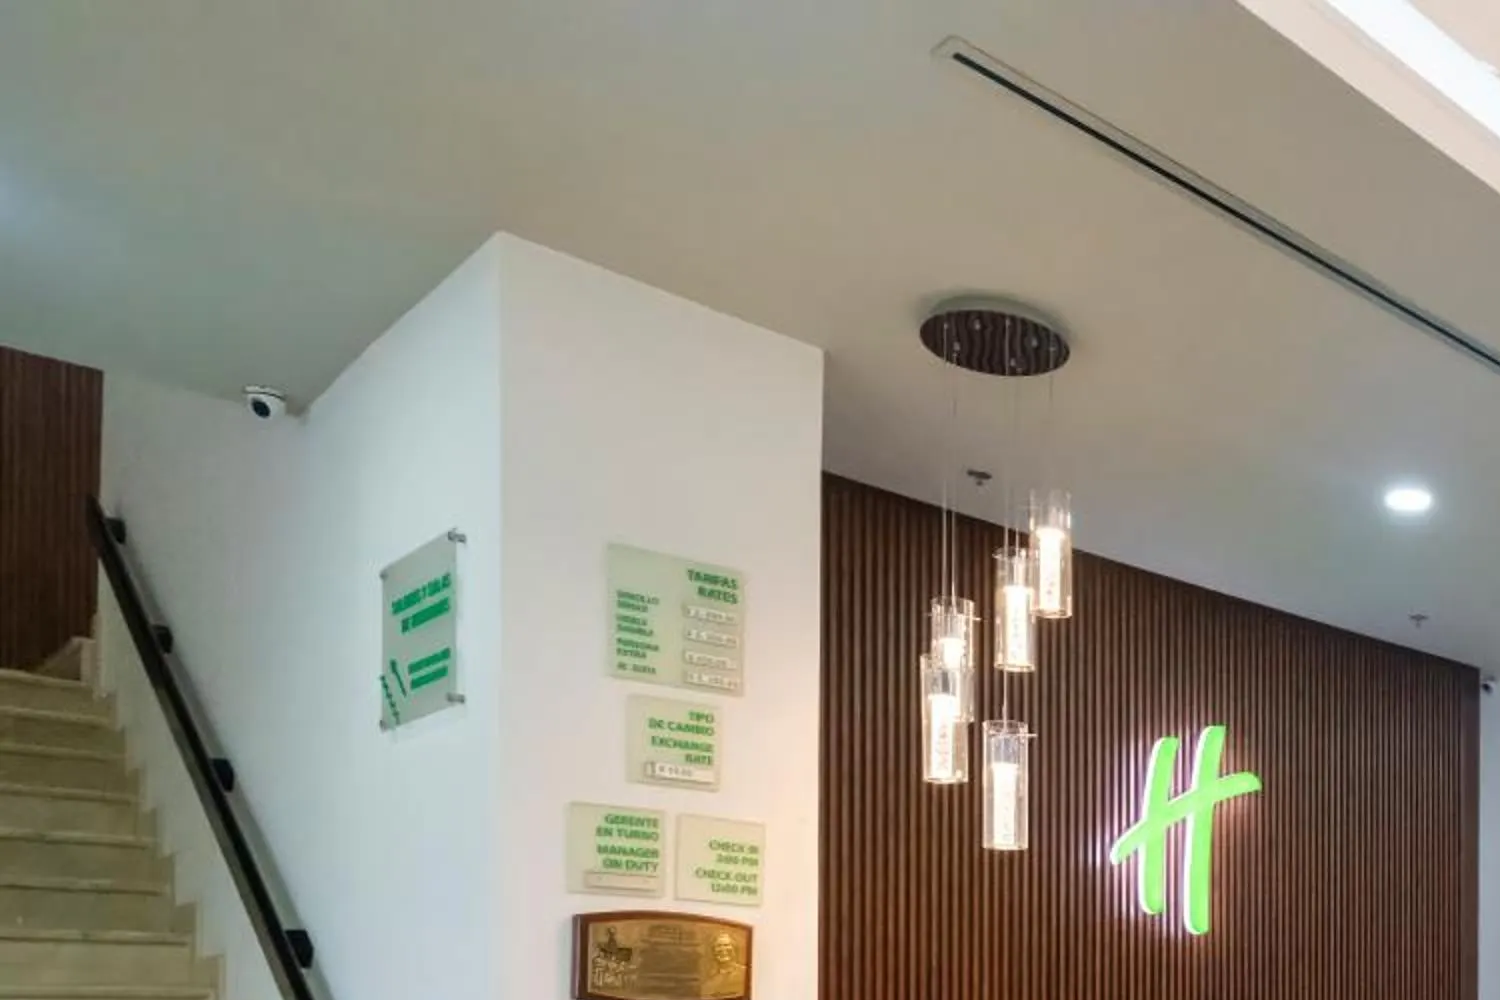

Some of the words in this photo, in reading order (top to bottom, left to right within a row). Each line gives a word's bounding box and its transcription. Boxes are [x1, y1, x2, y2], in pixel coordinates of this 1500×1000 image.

[604, 813, 659, 829] GERENTE
[595, 825, 613, 837] EN
[1109, 724, 1262, 935] H
[597, 843, 659, 860] MANAGER
[625, 861, 659, 873] DUTY
